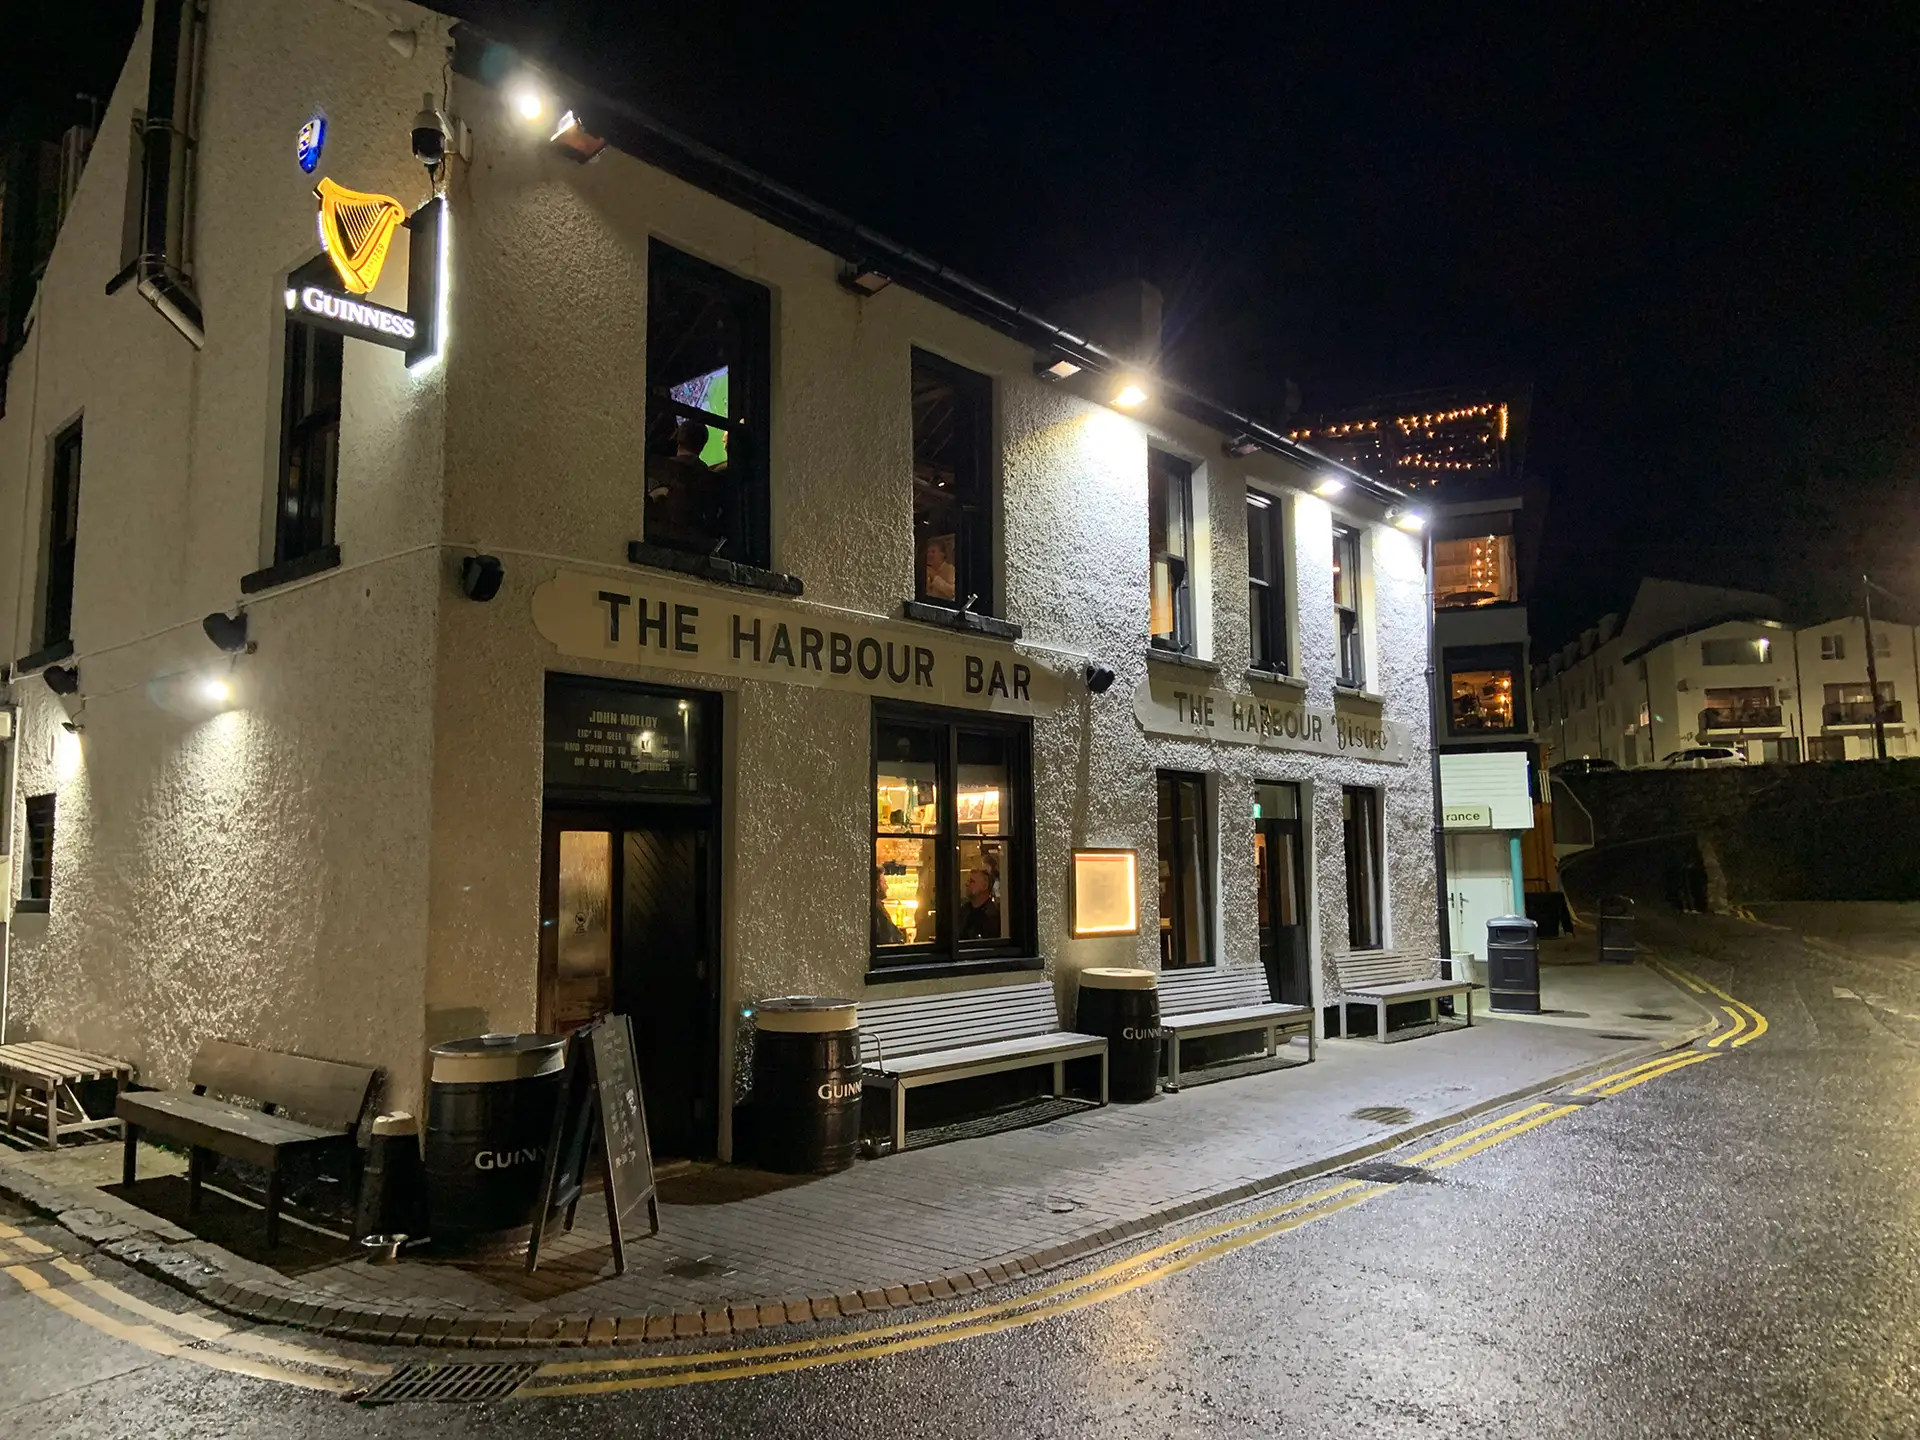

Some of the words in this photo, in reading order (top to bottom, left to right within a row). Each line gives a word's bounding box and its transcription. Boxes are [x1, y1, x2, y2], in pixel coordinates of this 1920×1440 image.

[302, 286, 415, 338] GUINNESS
[599, 591, 699, 653] THE
[732, 614, 935, 689] HARBOUR
[965, 656, 1031, 701] BAR
[589, 710, 617, 725] JOHN
[620, 713, 658, 729] MOLLOY
[1174, 691, 1215, 727] THE
[1232, 701, 1322, 742] HARBOUR
[564, 741, 580, 752] AND
[584, 743, 614, 755] SPIRITS
[617, 746, 626, 755] TO
[1444, 812, 1480, 821] rance
